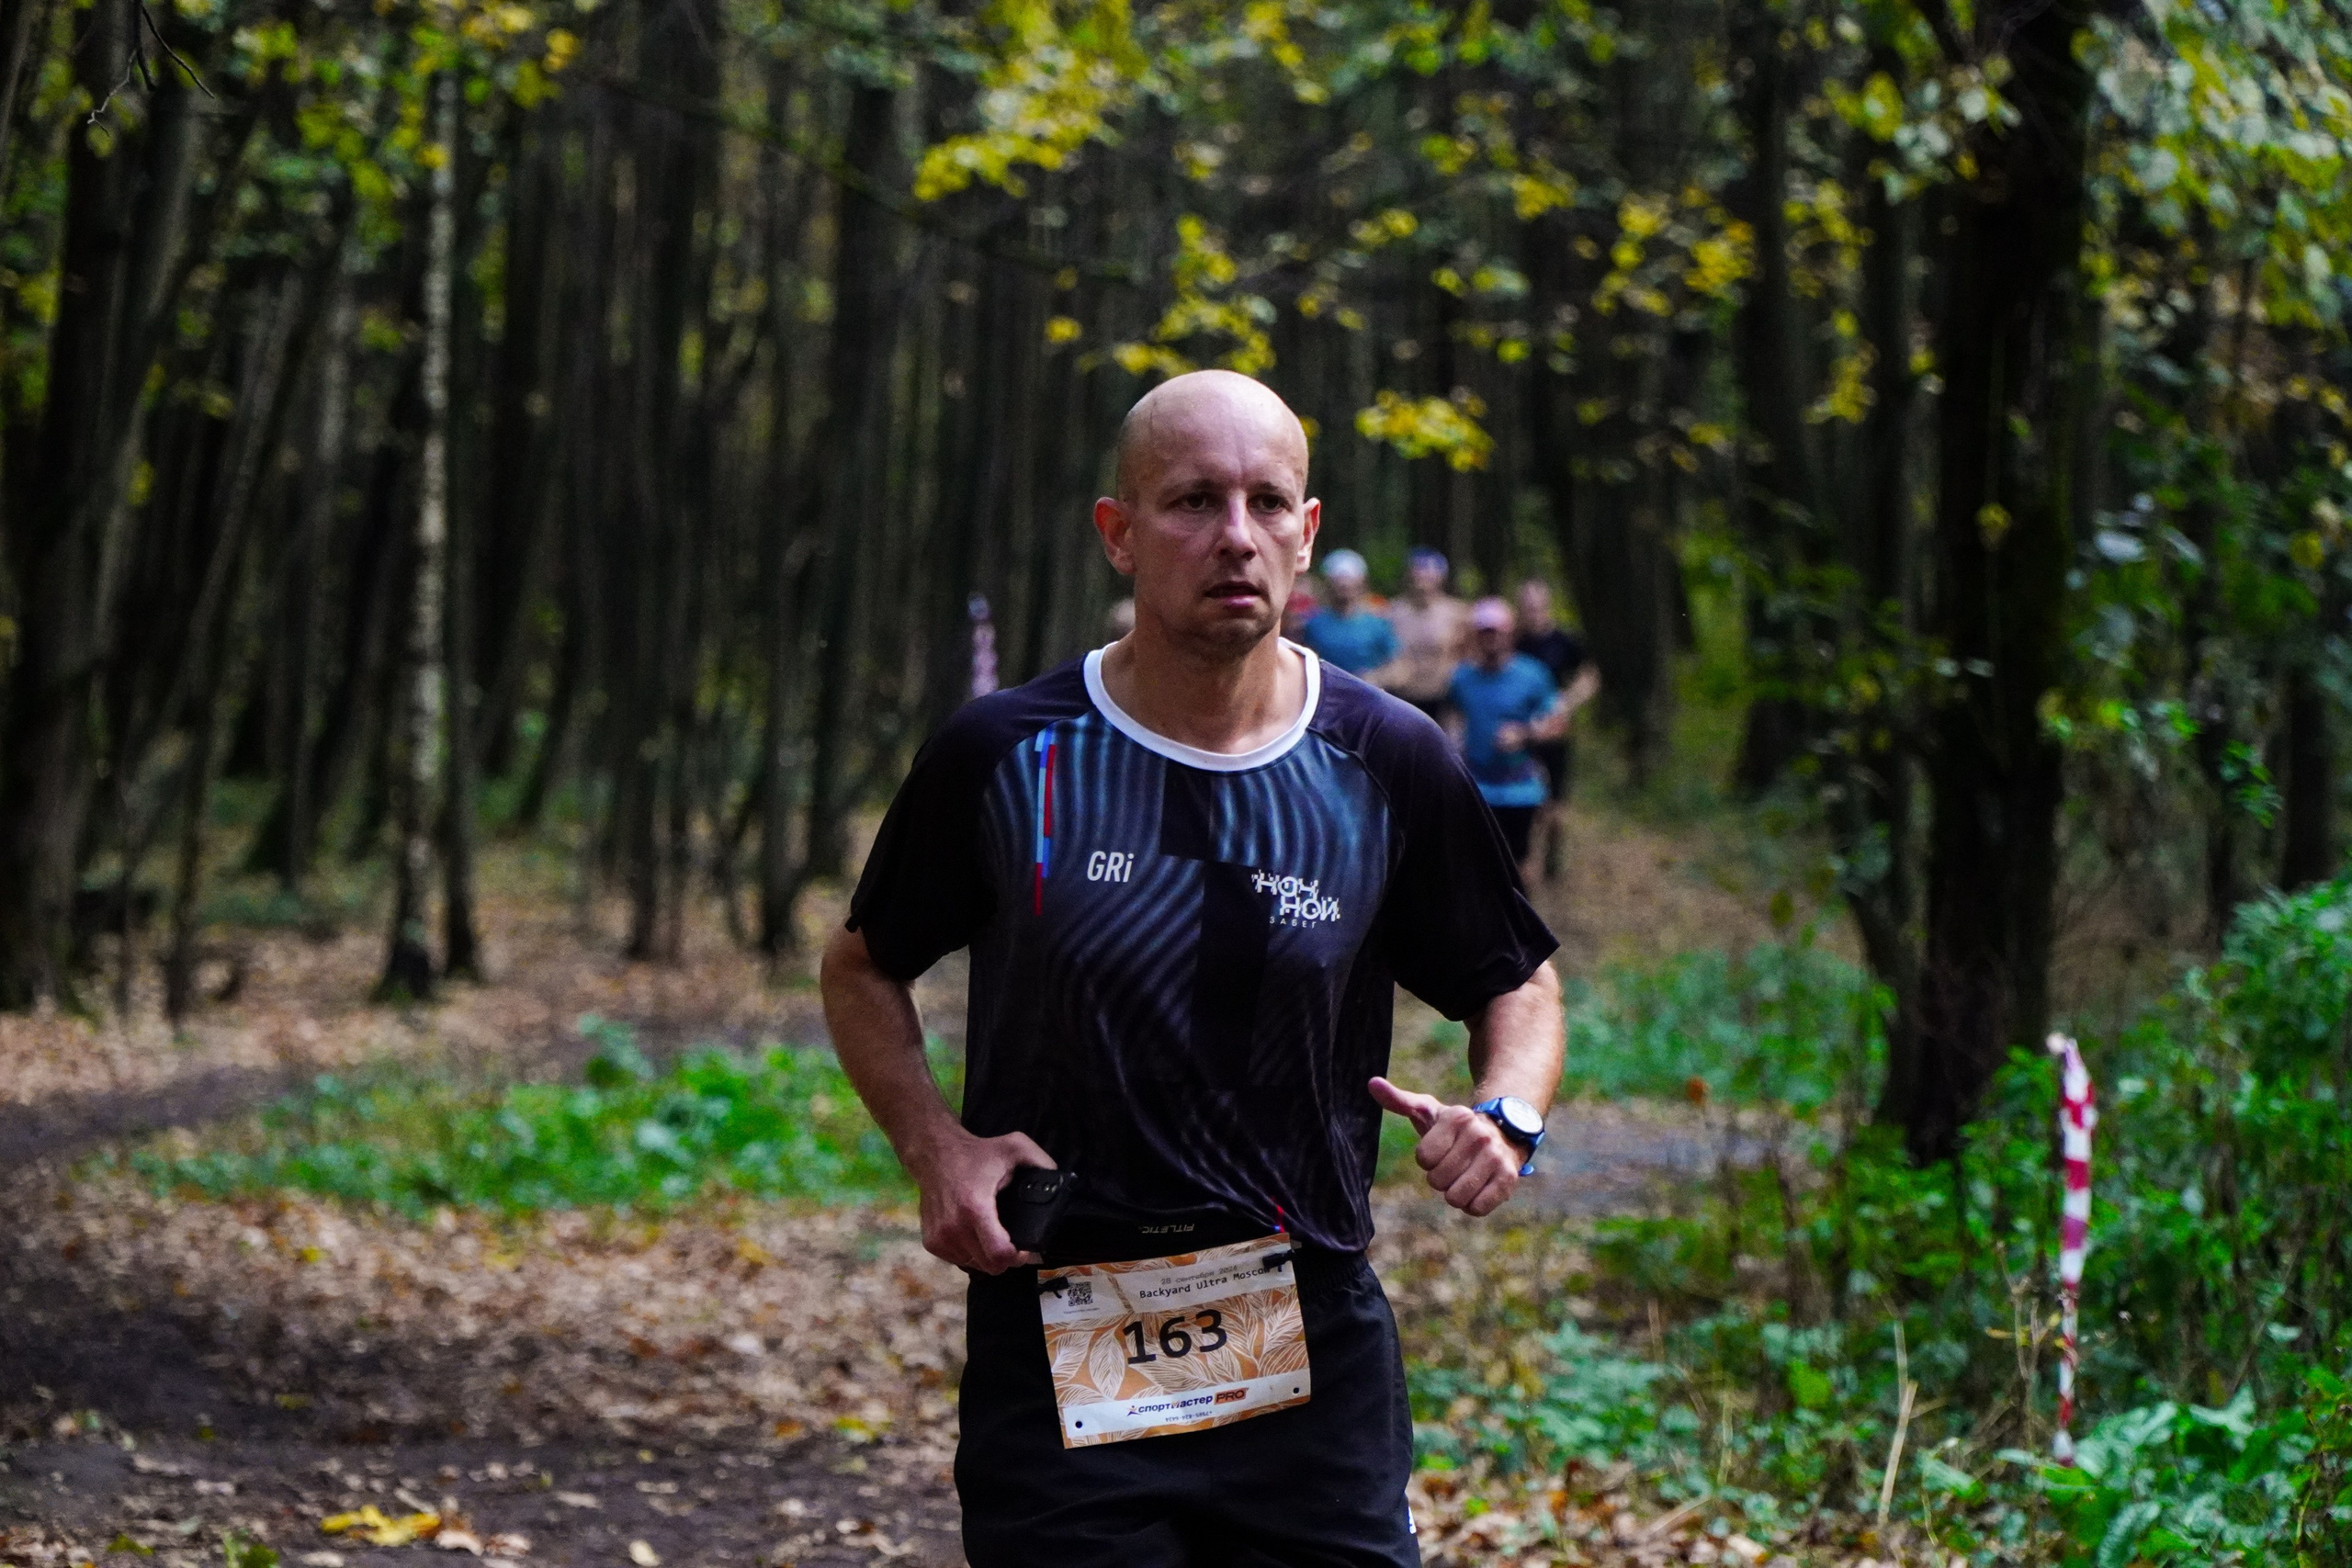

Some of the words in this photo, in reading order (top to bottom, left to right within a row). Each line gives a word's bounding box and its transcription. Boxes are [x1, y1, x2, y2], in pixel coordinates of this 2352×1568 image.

[1087, 850, 1135, 883] GRi
[1269, 916, 1317, 930] ЗАБЕГ
[1141, 1223, 1195, 1235] FITLETIC
[1139, 1282, 1191, 1300] Backyard
[1197, 1275, 1227, 1291] Ultra
[1122, 1309, 1227, 1365] 163
[1215, 1389, 1246, 1404] PRO
